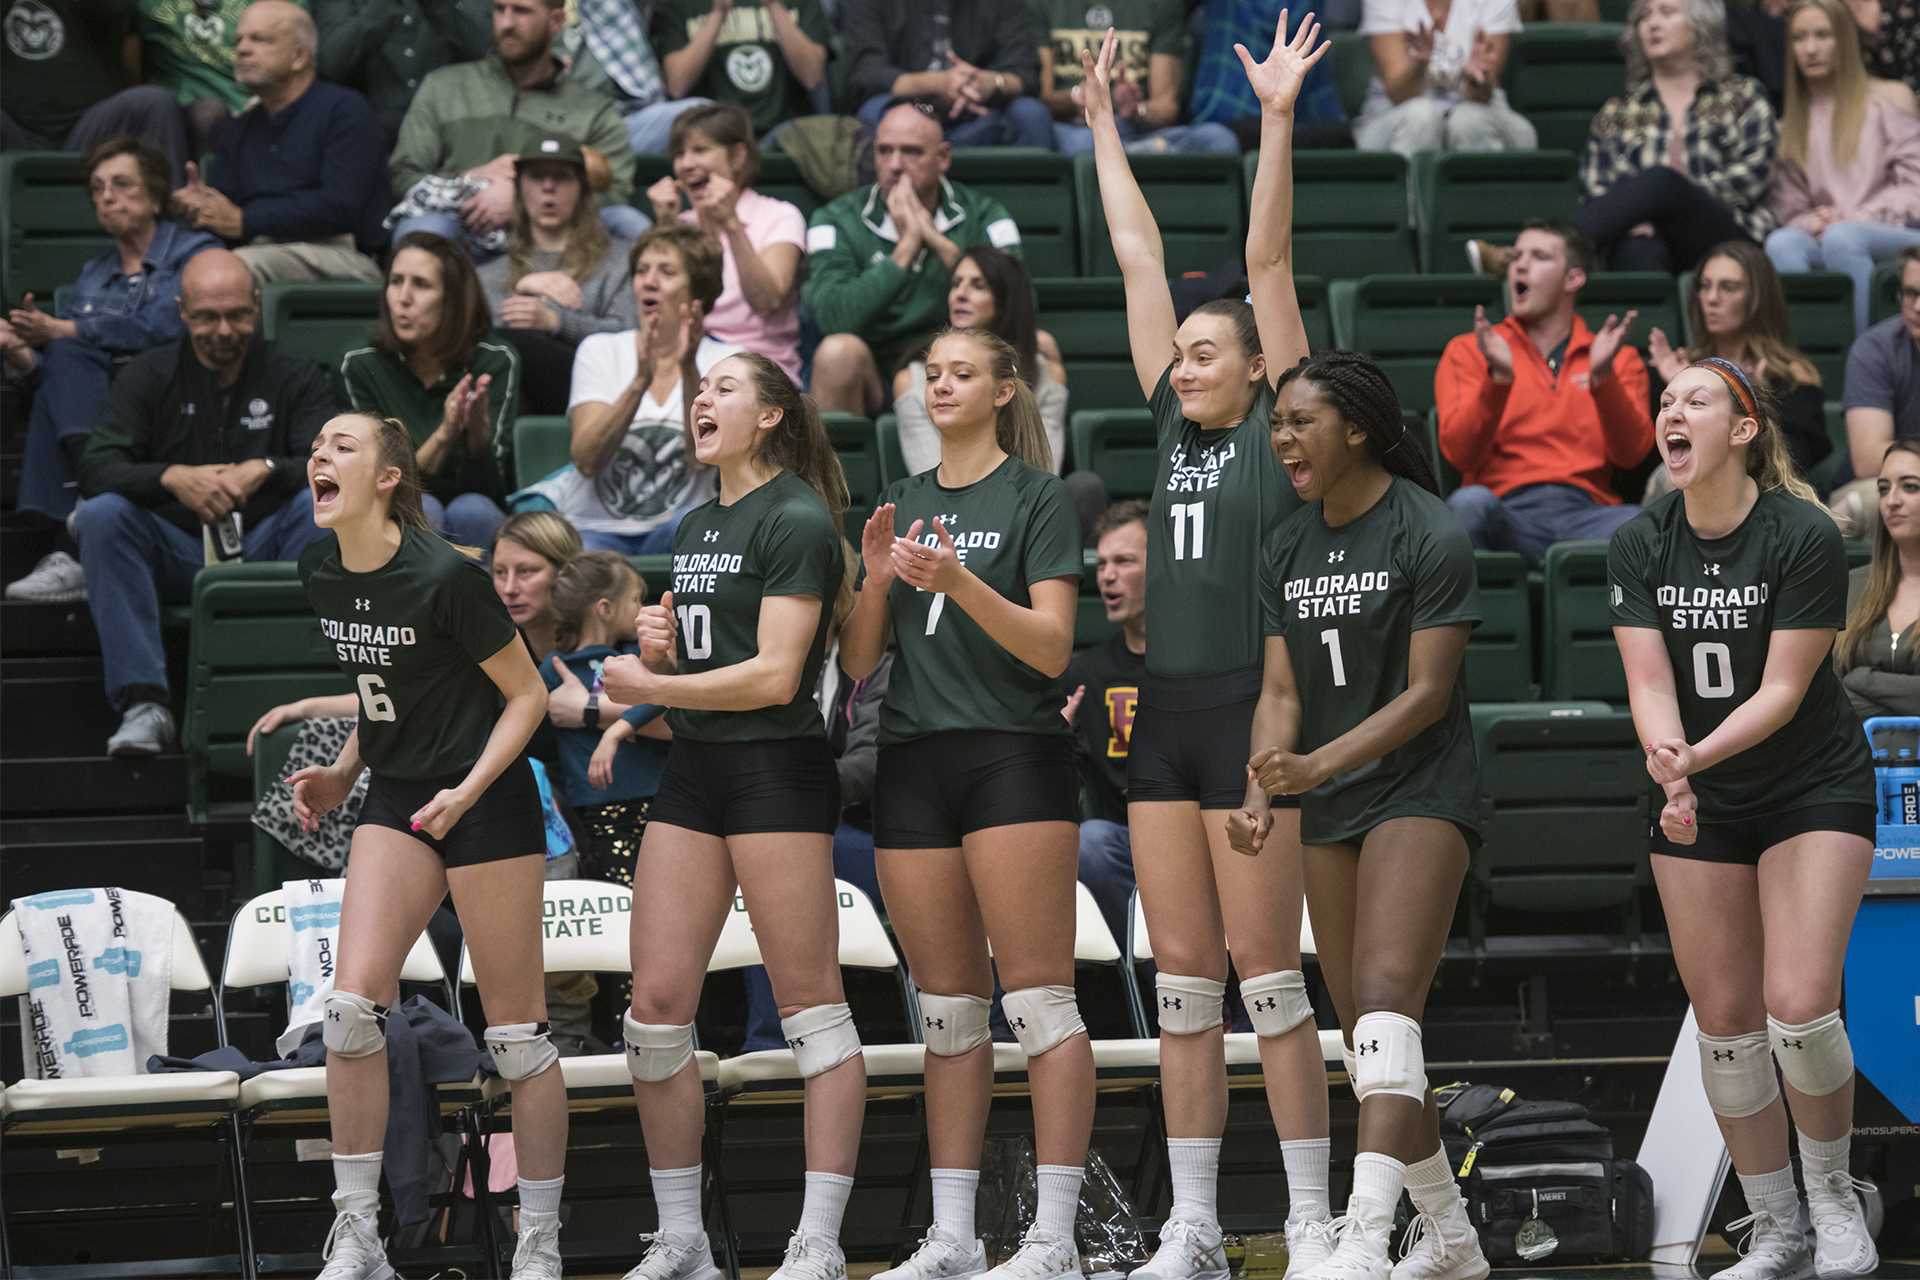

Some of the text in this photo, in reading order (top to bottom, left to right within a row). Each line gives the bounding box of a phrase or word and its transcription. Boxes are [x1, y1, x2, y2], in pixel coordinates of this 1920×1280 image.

[895, 531, 1001, 550] OADO
[1170, 501, 1204, 560] 11
[673, 553, 743, 573] COLORADO
[673, 574, 717, 593] STATE
[1284, 571, 1389, 601] COLORADO
[1656, 583, 1769, 607] COLORADO
[1298, 594, 1361, 619] STATE
[1672, 609, 1748, 629] STATE
[320, 618, 416, 646] COLORADO
[677, 604, 712, 660] 10
[336, 643, 392, 666] STATE
[1321, 628, 1347, 687] 1
[1692, 642, 1735, 699] 0
[357, 673, 396, 722] 6
[57, 914, 93, 1018] POWERADE
